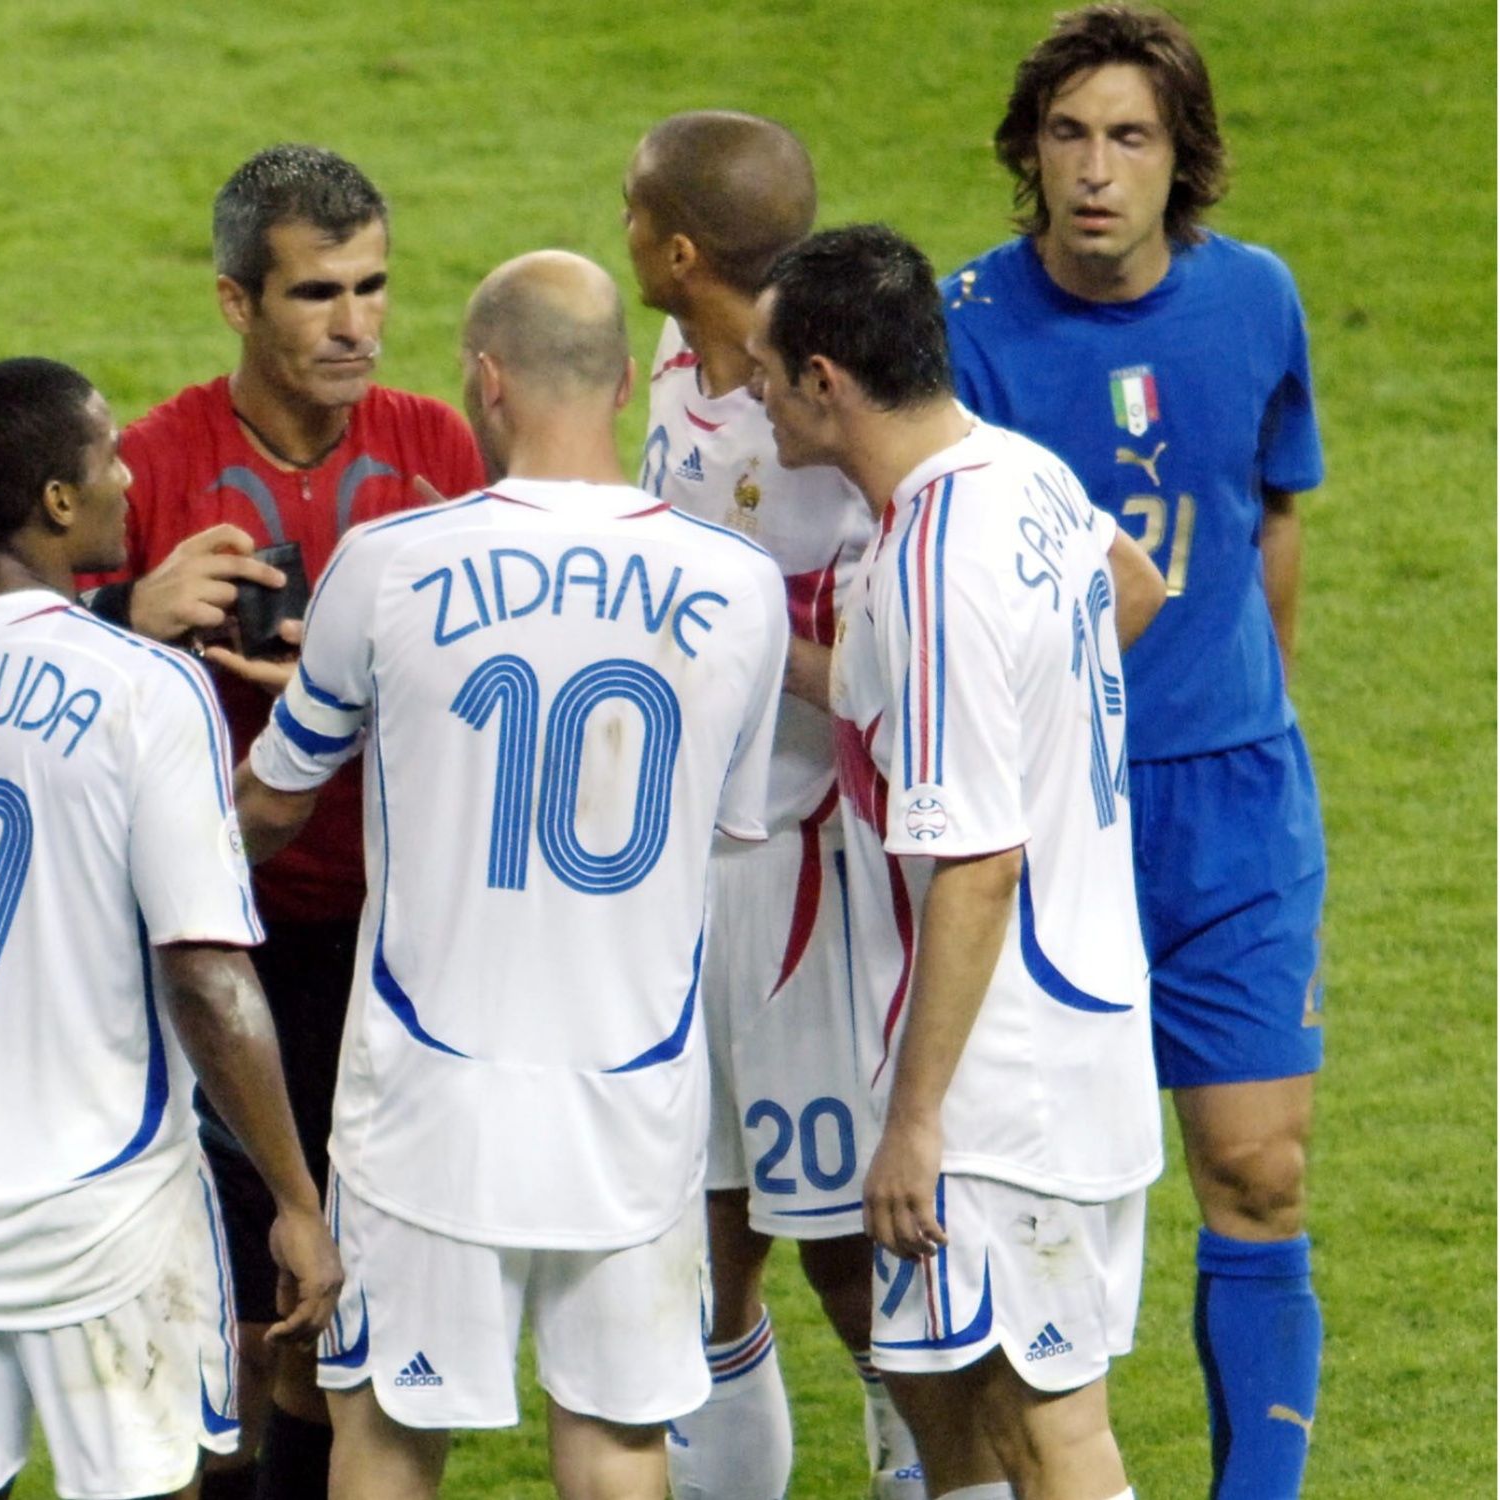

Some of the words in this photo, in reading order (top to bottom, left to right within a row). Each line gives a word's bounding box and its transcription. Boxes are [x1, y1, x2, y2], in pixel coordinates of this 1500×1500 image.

[411, 546, 730, 659] ZIDANE
[449, 653, 682, 897] 10
[744, 1096, 857, 1195] 20
[394, 1374, 443, 1388] adidas
[1024, 1342, 1074, 1362] adidas
